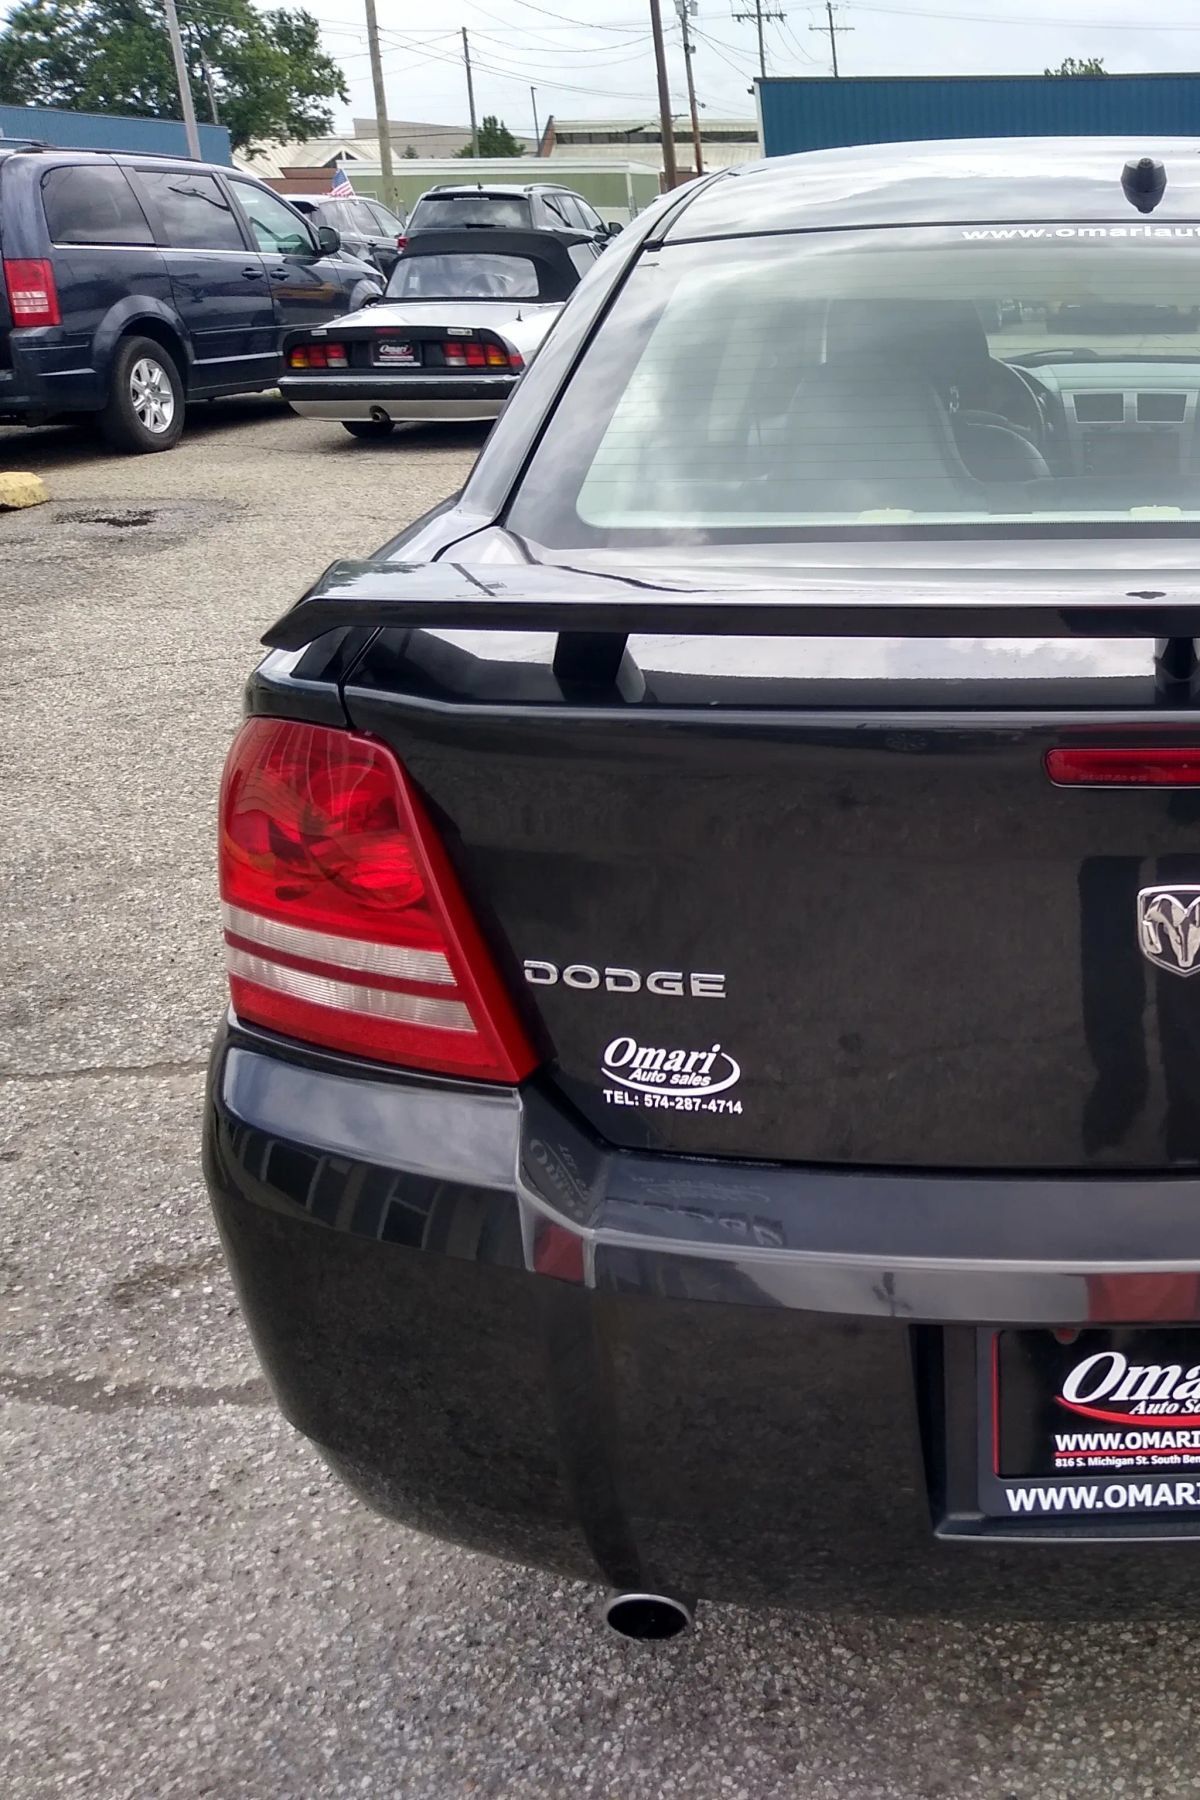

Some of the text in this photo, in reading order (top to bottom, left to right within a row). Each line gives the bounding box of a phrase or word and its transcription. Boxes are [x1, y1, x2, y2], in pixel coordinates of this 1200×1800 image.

[524, 959, 727, 998] DODGE
[603, 1037, 721, 1075] Omari
[628, 1067, 712, 1087] Auto sales
[603, 1089, 744, 1115] TEL: 574-287-4714
[1128, 1399, 1180, 1416] Auto
[1054, 1457, 1075, 1468] 816
[1076, 1457, 1087, 1467] S.
[1087, 1456, 1134, 1468] Michigan
[1135, 1455, 1150, 1466] St.
[1150, 1454, 1181, 1465] South
